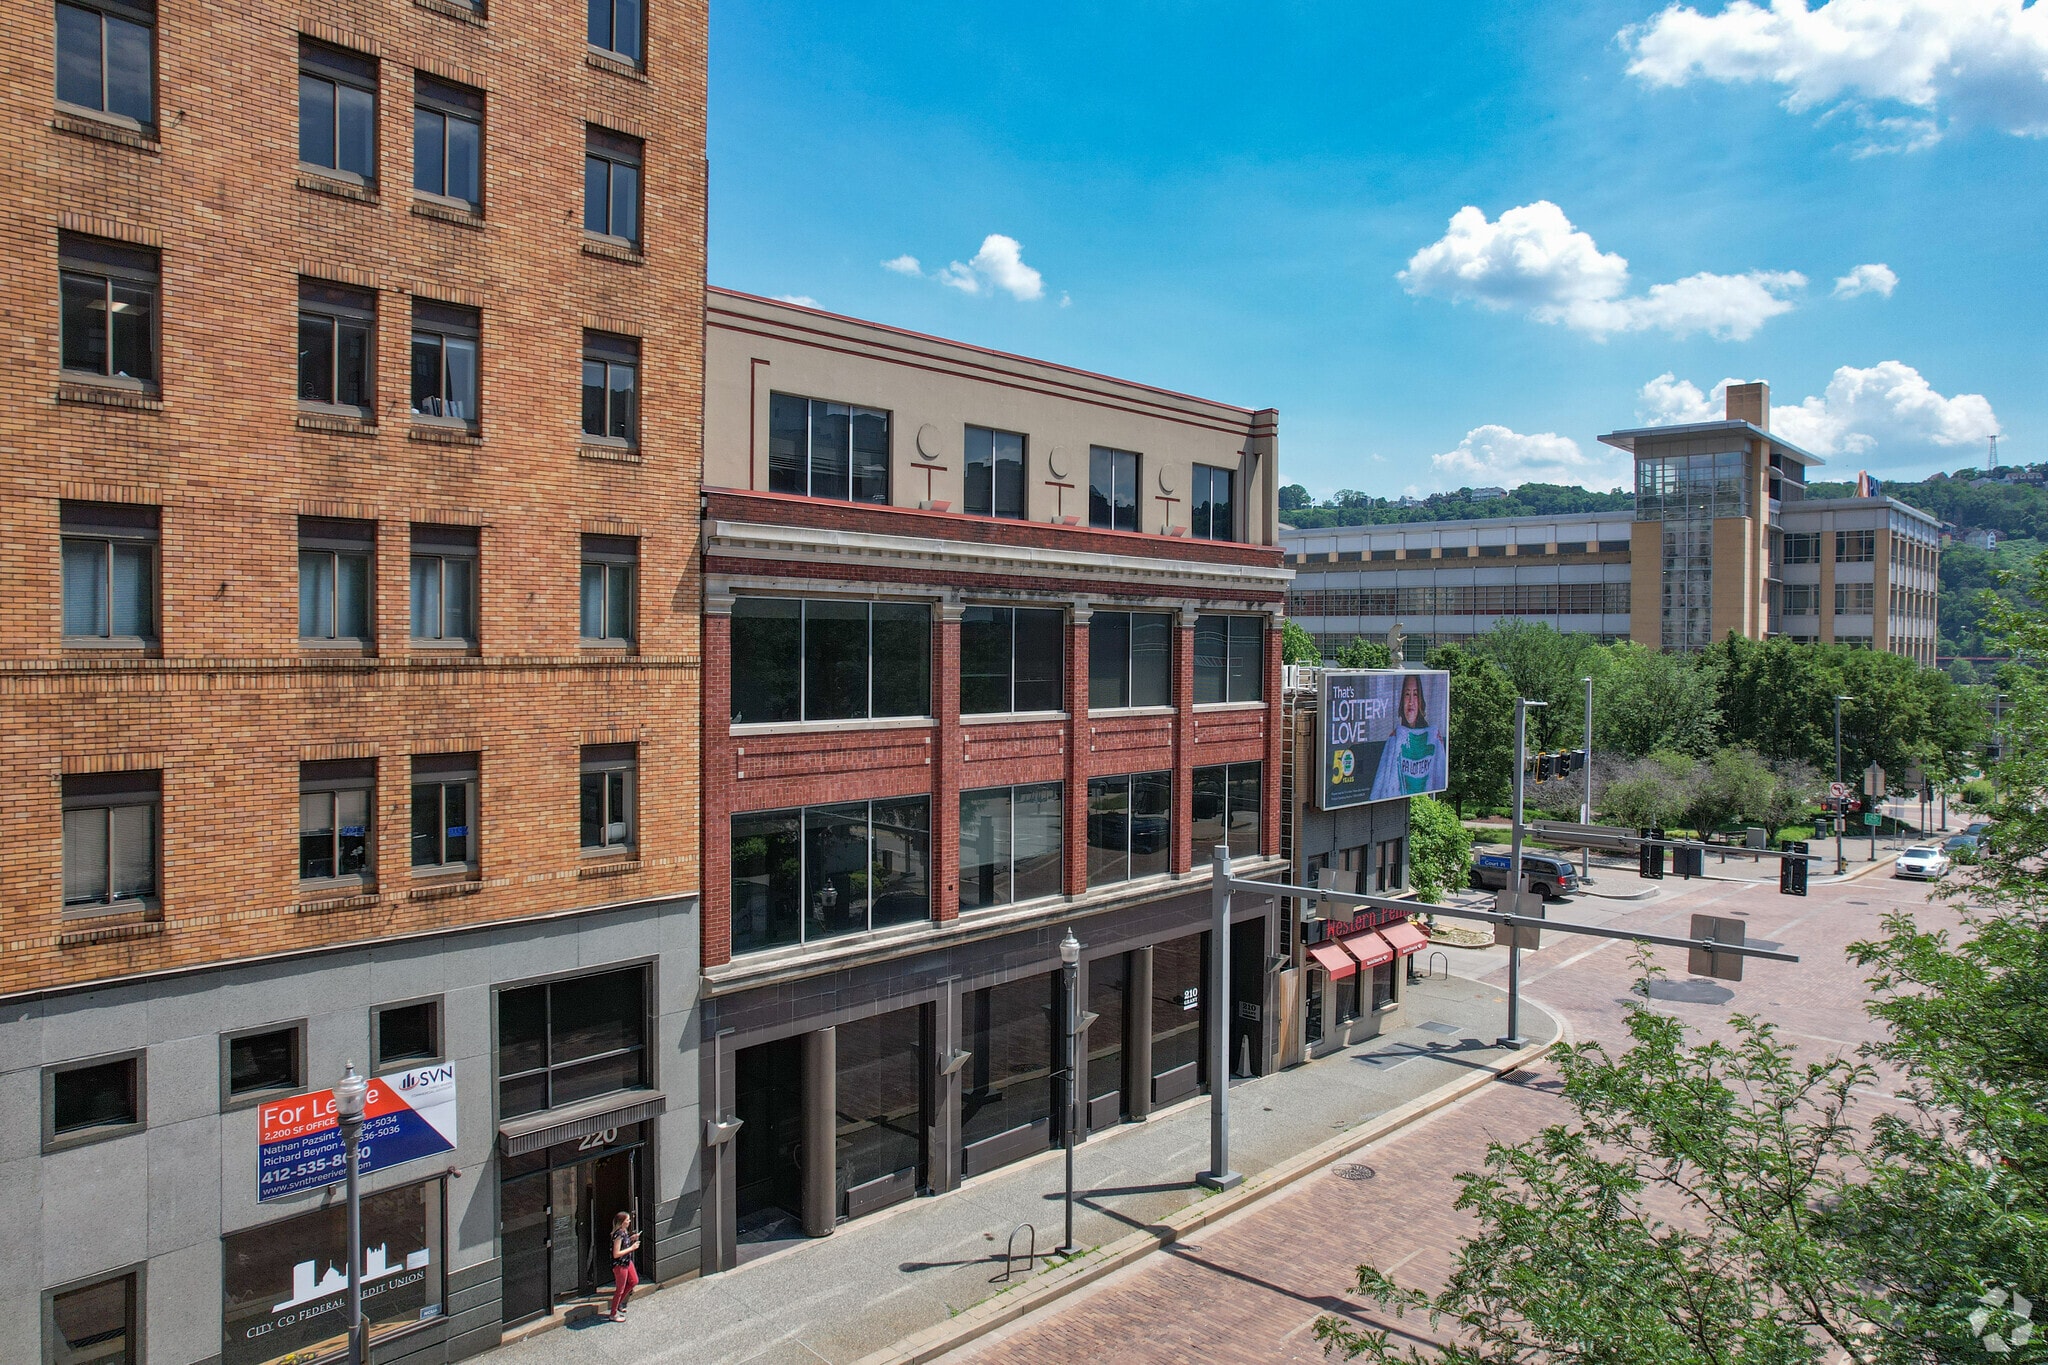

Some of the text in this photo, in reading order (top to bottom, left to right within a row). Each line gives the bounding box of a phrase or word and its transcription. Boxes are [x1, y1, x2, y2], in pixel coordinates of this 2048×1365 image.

[1333, 685, 1355, 699] That's
[1332, 698, 1389, 721] LOTTERY
[1332, 721, 1368, 745] LOVE.
[1331, 749, 1355, 785] 50
[1410, 759, 1432, 776] LOTTERY
[1184, 987, 1198, 1000] 210
[1242, 1002, 1256, 1012] 210
[419, 1065, 453, 1086] SVN
[264, 1105, 305, 1129] For
[312, 1088, 379, 1119] Lee
[264, 1117, 336, 1141] 2,200 SF OFFICE
[578, 1127, 618, 1151] 220
[263, 1142, 300, 1156] Nathan
[302, 1131, 336, 1147] Pazsint
[263, 1150, 301, 1167] Richard
[303, 1142, 338, 1158] Beynon
[262, 1161, 371, 1196] www.svnthreeriverom
[246, 1270, 425, 1339] CITY CO FEDERAL EDIT UNION
